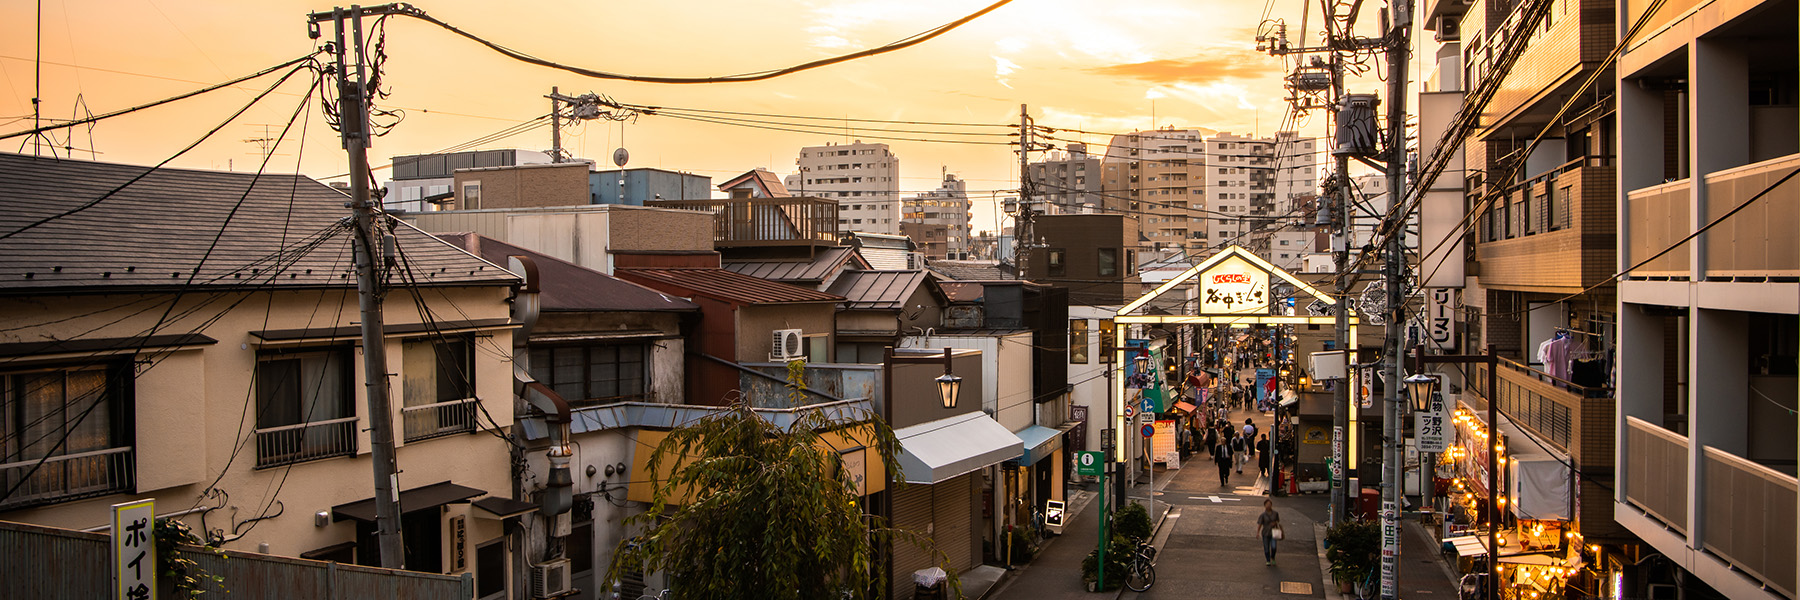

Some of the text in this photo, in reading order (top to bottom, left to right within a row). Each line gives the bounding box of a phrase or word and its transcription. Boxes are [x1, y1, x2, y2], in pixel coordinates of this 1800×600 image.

[1212, 272, 1252, 285] ひぐらしの里
[1205, 281, 1264, 309] 谷中ぎんざ
